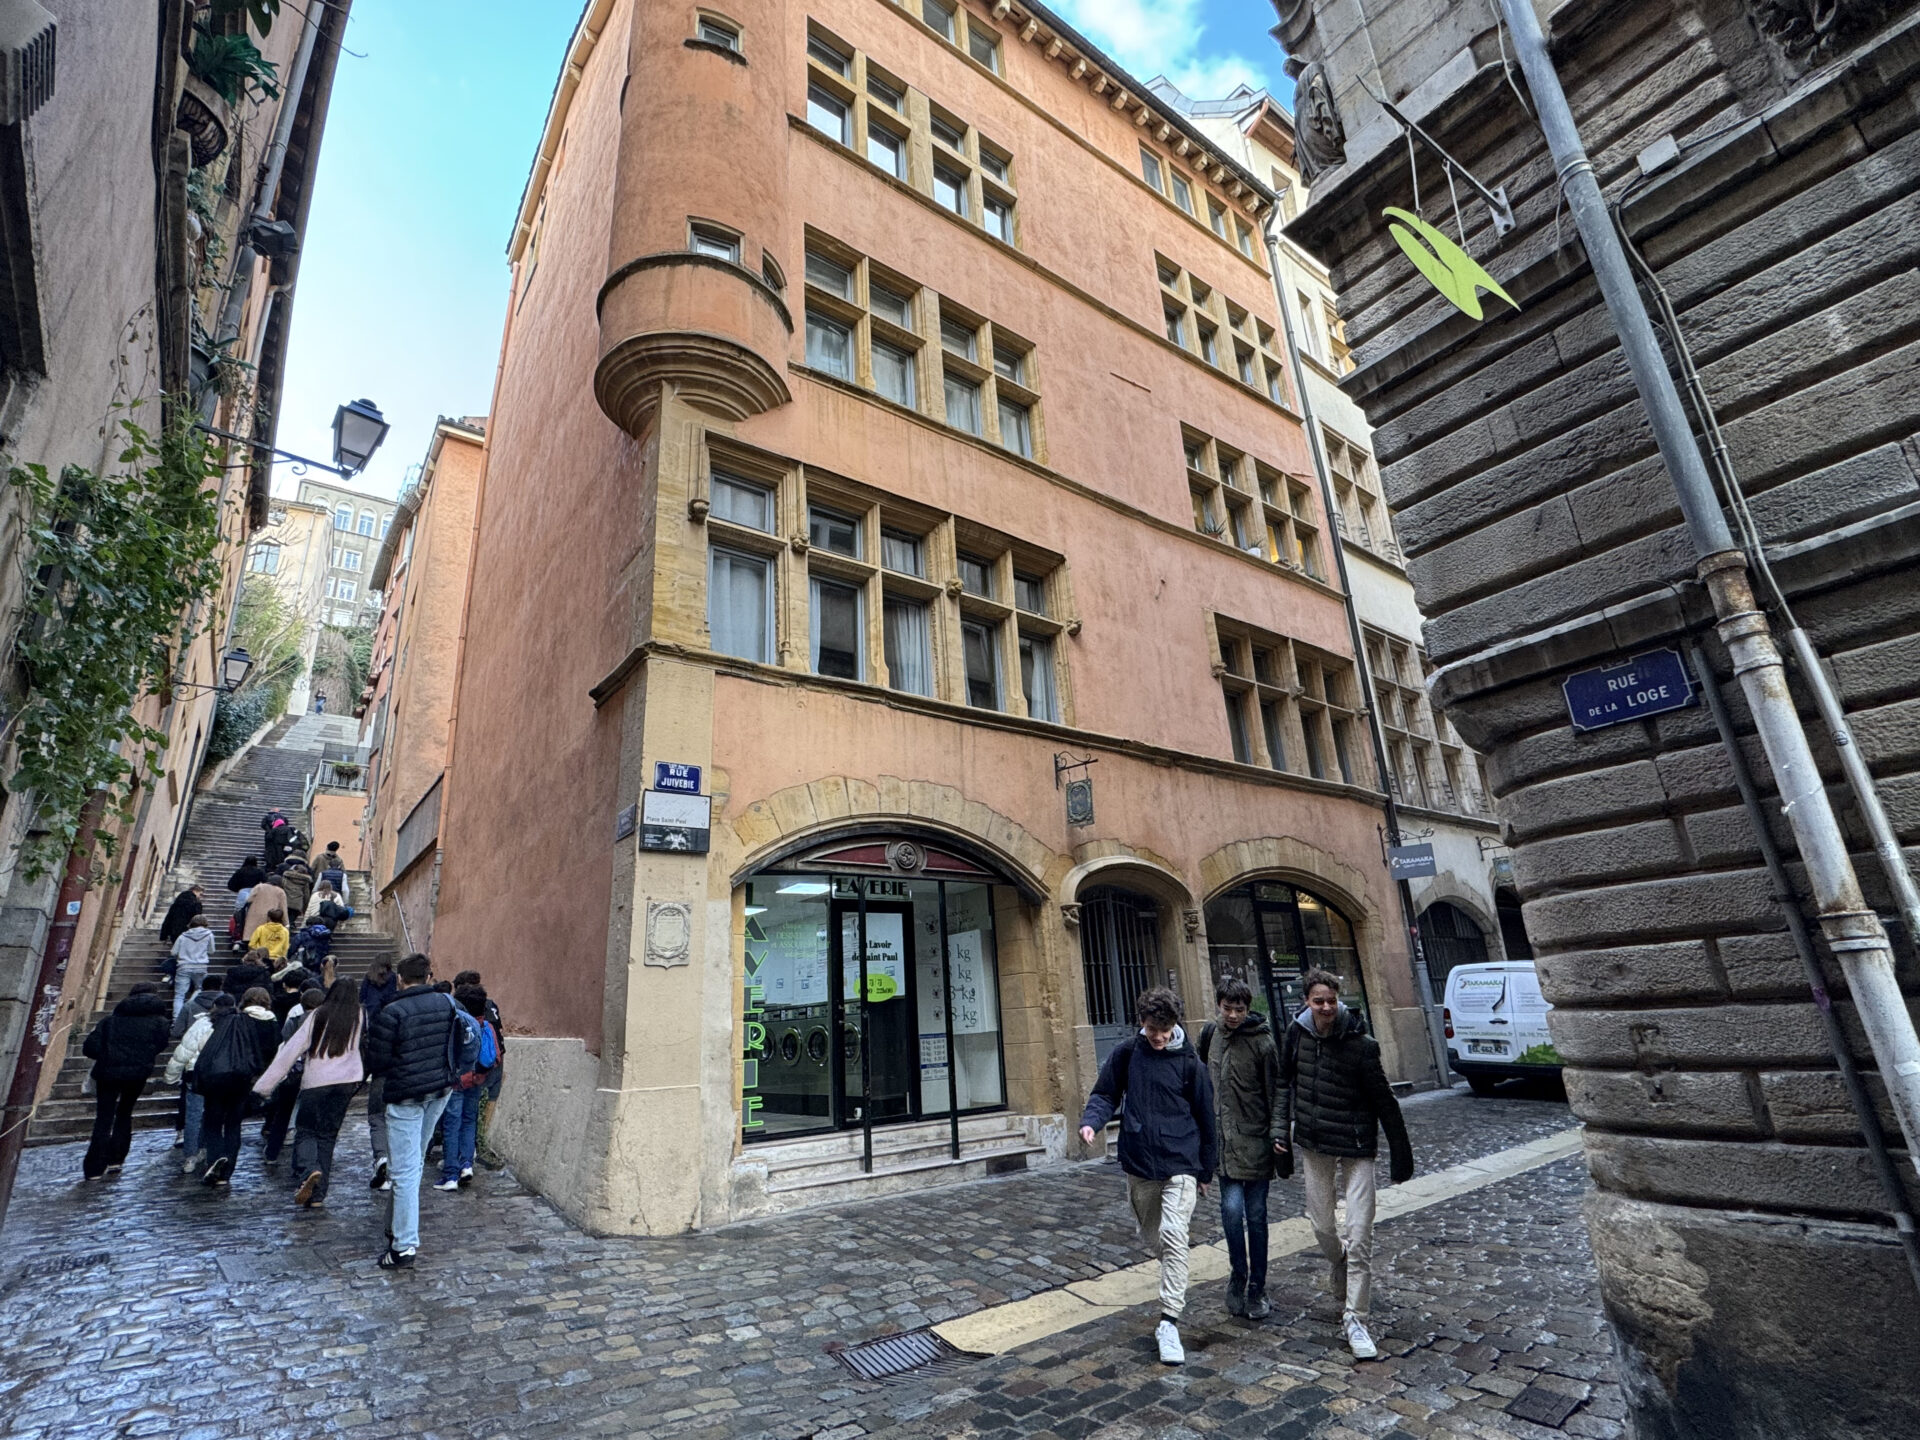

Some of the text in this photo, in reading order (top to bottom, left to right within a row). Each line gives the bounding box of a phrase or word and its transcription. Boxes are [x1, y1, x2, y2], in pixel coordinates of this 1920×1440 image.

[1607, 672, 1638, 692] RUE
[1588, 685, 1670, 717] DE LA LOGE
[669, 768, 689, 777] RUE
[1399, 856, 1433, 865] TAKAMAKA
[869, 940, 892, 948] Lavoir
[866, 952, 881, 961] aint
[882, 952, 898, 961] Paul
[956, 944, 971, 962] kg
[957, 964, 972, 982] kg
